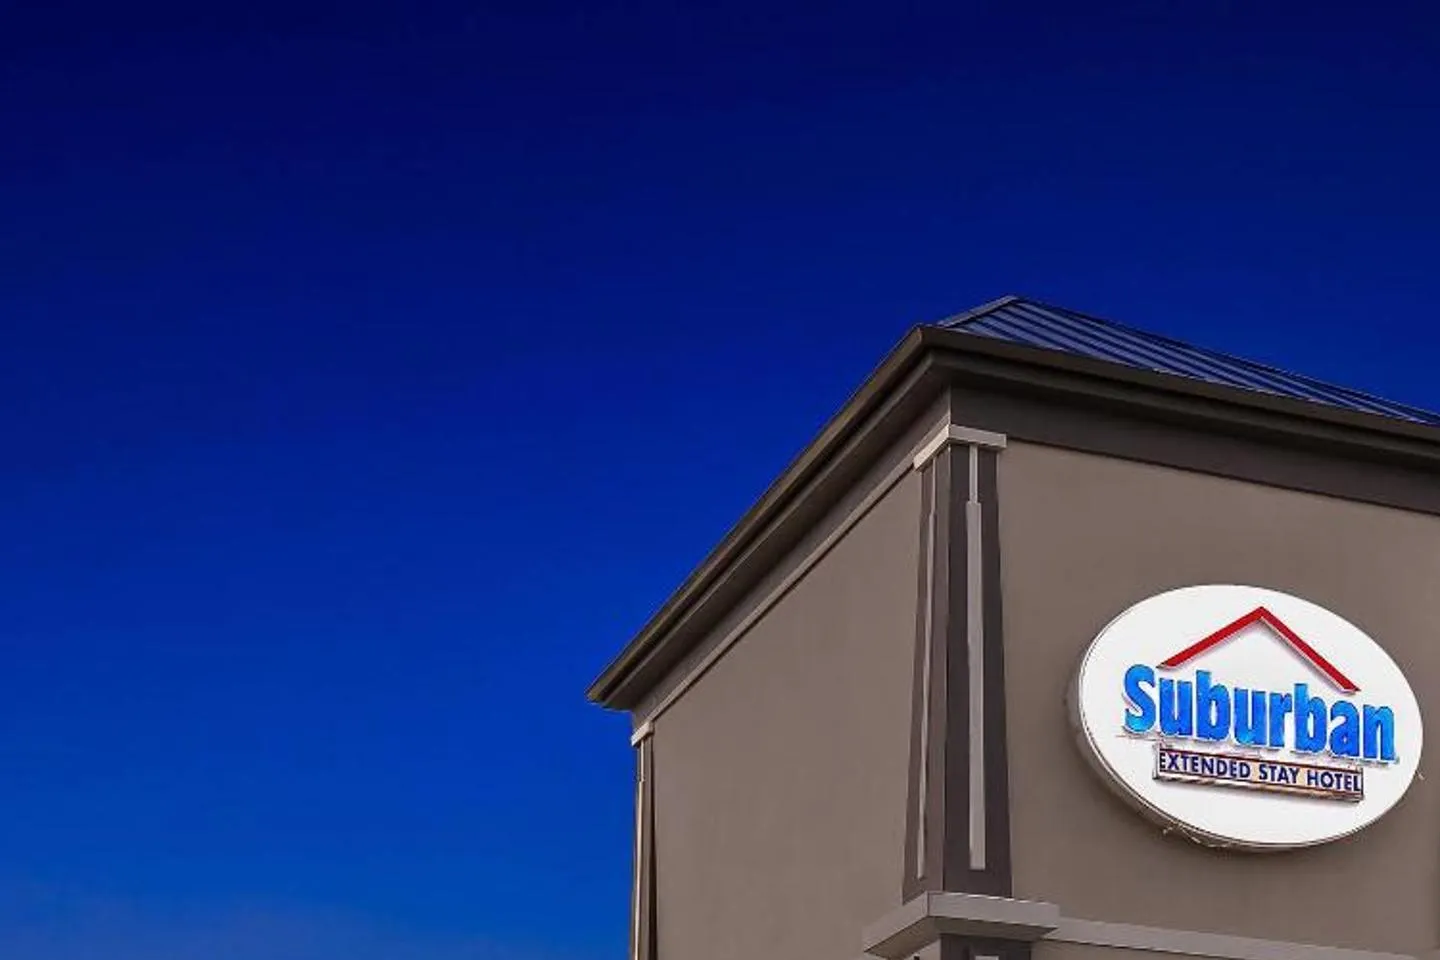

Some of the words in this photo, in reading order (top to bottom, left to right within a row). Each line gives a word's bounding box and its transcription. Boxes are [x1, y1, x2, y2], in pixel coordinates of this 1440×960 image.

[1123, 664, 1396, 761] Suburban
[1159, 752, 1250, 779] EXTENDED
[1259, 764, 1299, 784] STAY
[1307, 770, 1362, 792] HOTEL
